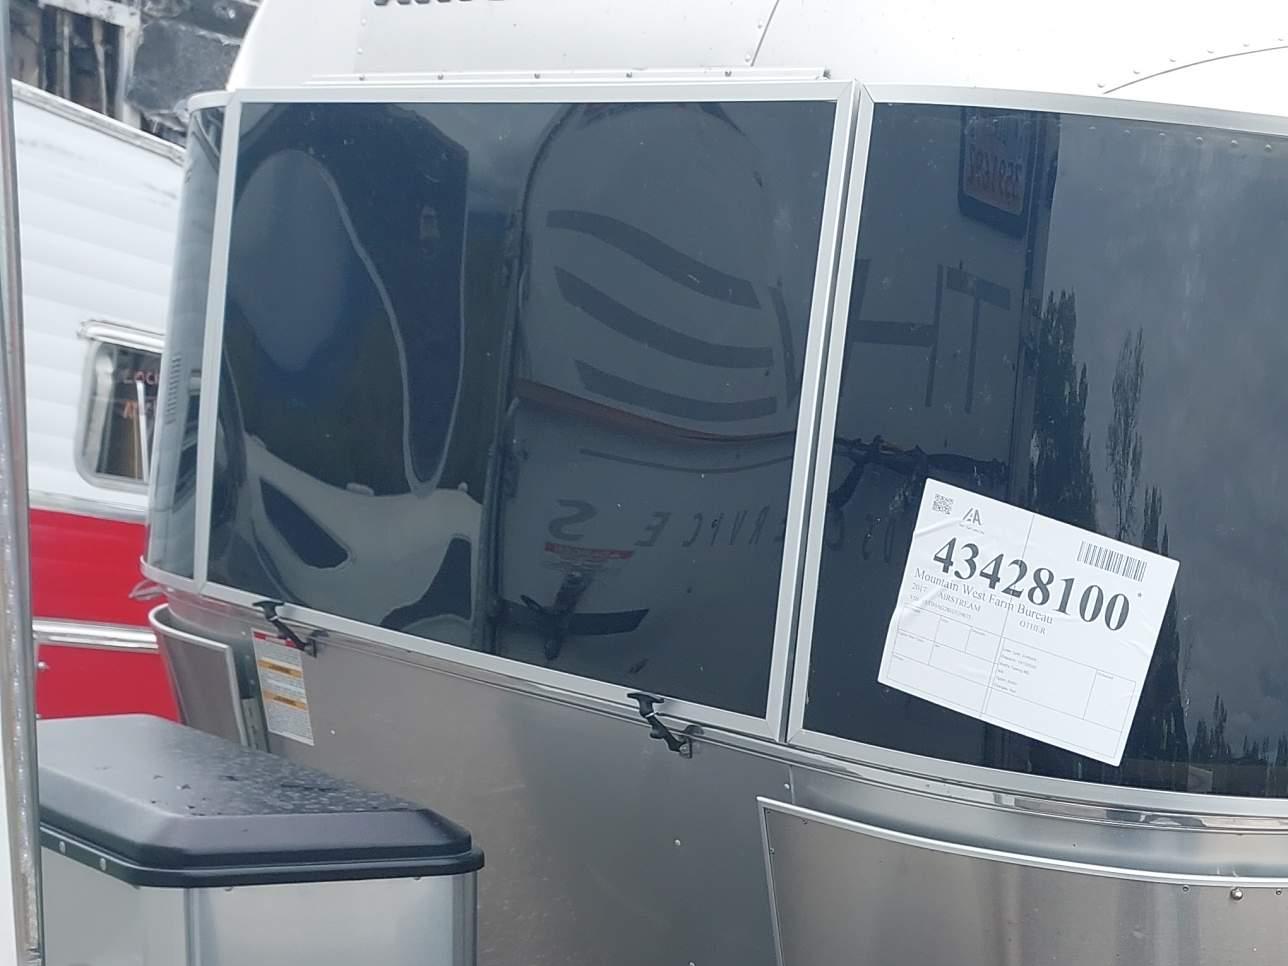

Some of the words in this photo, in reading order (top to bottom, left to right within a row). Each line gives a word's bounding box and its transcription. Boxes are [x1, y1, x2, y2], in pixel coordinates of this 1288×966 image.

[914, 567, 959, 592] Mountain
[961, 583, 987, 602] West
[988, 593, 1015, 612] Farm
[1016, 602, 1054, 625] Bureau
[932, 537, 1131, 632] 43428100
[938, 591, 982, 612] AIRSTREAM
[1019, 620, 1047, 636] OTHER
